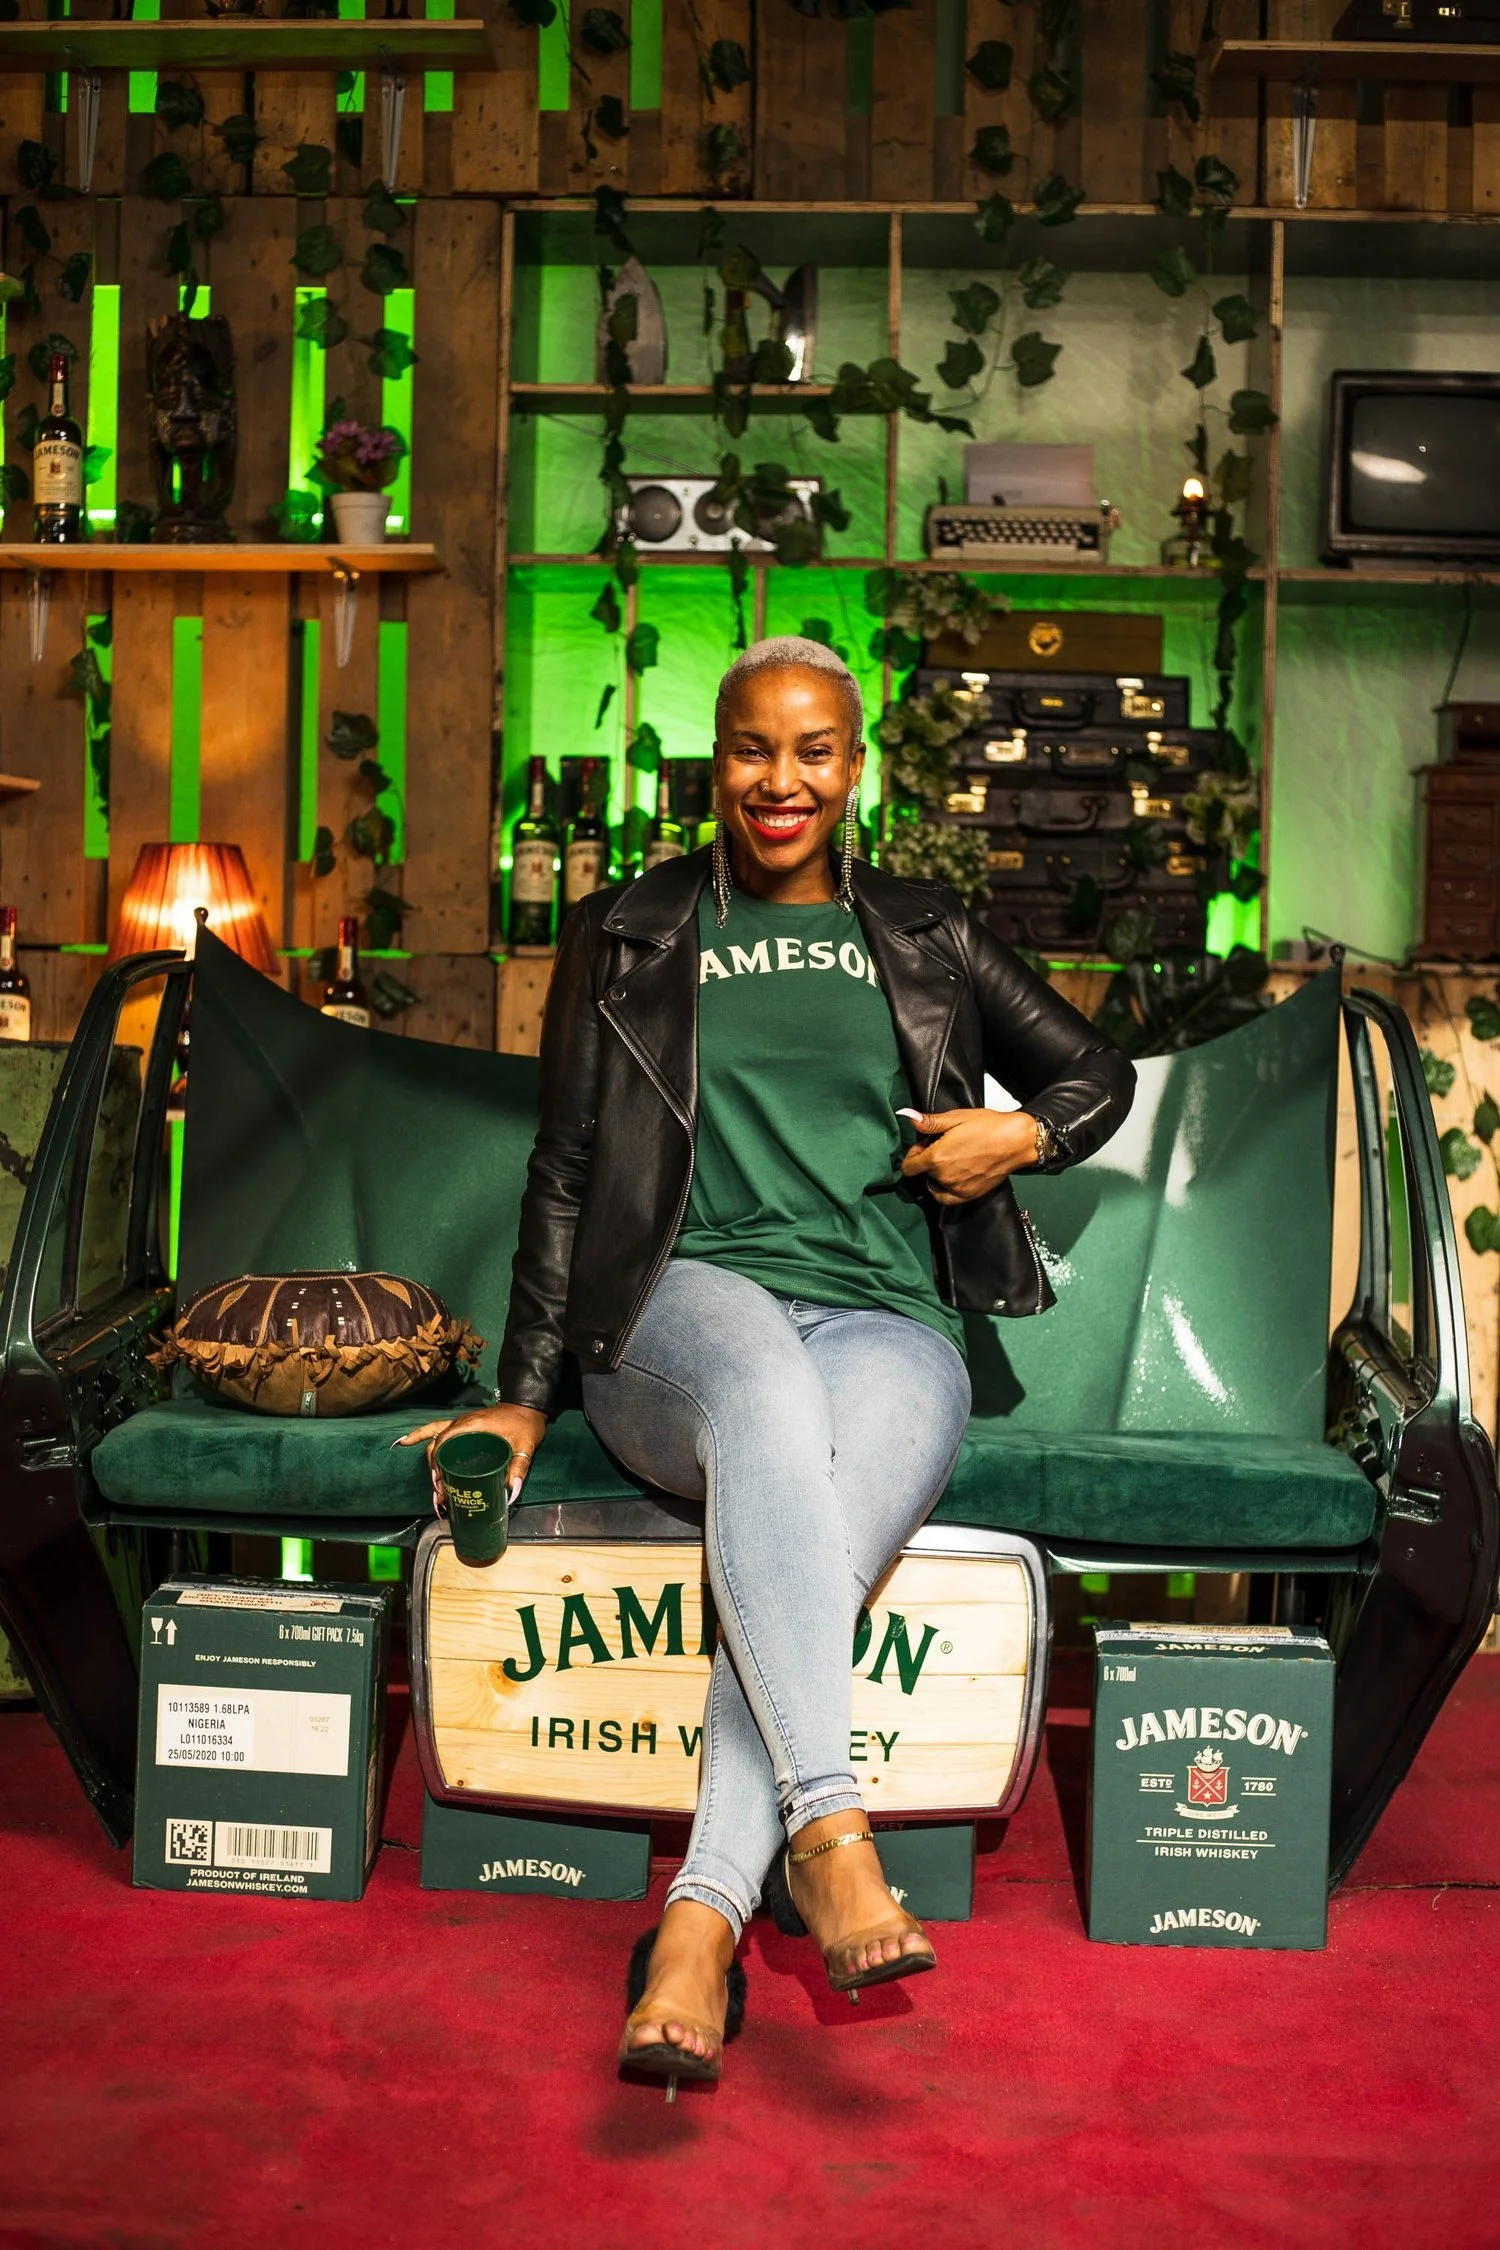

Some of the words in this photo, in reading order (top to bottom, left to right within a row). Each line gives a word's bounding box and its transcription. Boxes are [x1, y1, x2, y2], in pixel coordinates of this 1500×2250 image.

[700, 937, 879, 988] AMESO
[279, 1624, 284, 1639] 6
[284, 1628, 290, 1639] x
[291, 1624, 311, 1641] 700ml
[311, 1626, 326, 1642] GIFT
[326, 1626, 344, 1643] PACK
[346, 1627, 364, 1647] 7.5kg
[502, 1582, 940, 1696] JAMN
[1155, 1643, 1265, 1653] JAMESON
[195, 1654, 221, 1662] ENJOY
[222, 1656, 260, 1664] JAMESON
[261, 1658, 317, 1667] RESPONSIBLY
[1103, 1665, 1109, 1682] 6
[1115, 1666, 1137, 1682] 700ml
[168, 1701, 210, 1714] 10113589
[214, 1703, 250, 1715] 1.68LPA
[188, 1718, 226, 1730] NIGERIA
[531, 1716, 657, 1755] IRISH
[1116, 1707, 1304, 1756] JAMESON
[180, 1733, 233, 1746] L011016334
[168, 1749, 217, 1761] 25/05/2020
[221, 1751, 245, 1762] 10:00
[1244, 1781, 1274, 1792] 1780
[870, 1821, 905, 1831] SKEY
[1144, 1827, 1194, 1838] TRIPLE
[1198, 1829, 1268, 1840] DISTILLED
[1154, 1846, 1192, 1857] IRISH
[1195, 1848, 1259, 1859] WHISKEY
[190, 1869, 241, 1879] PRODUCT
[242, 1872, 257, 1881] OF
[260, 1873, 305, 1883] IRELAND
[479, 1858, 584, 1887] JAMESON
[186, 1878, 308, 1894] JAMESONWHISKEY.COM
[1149, 1908, 1259, 1936] JAMESON
